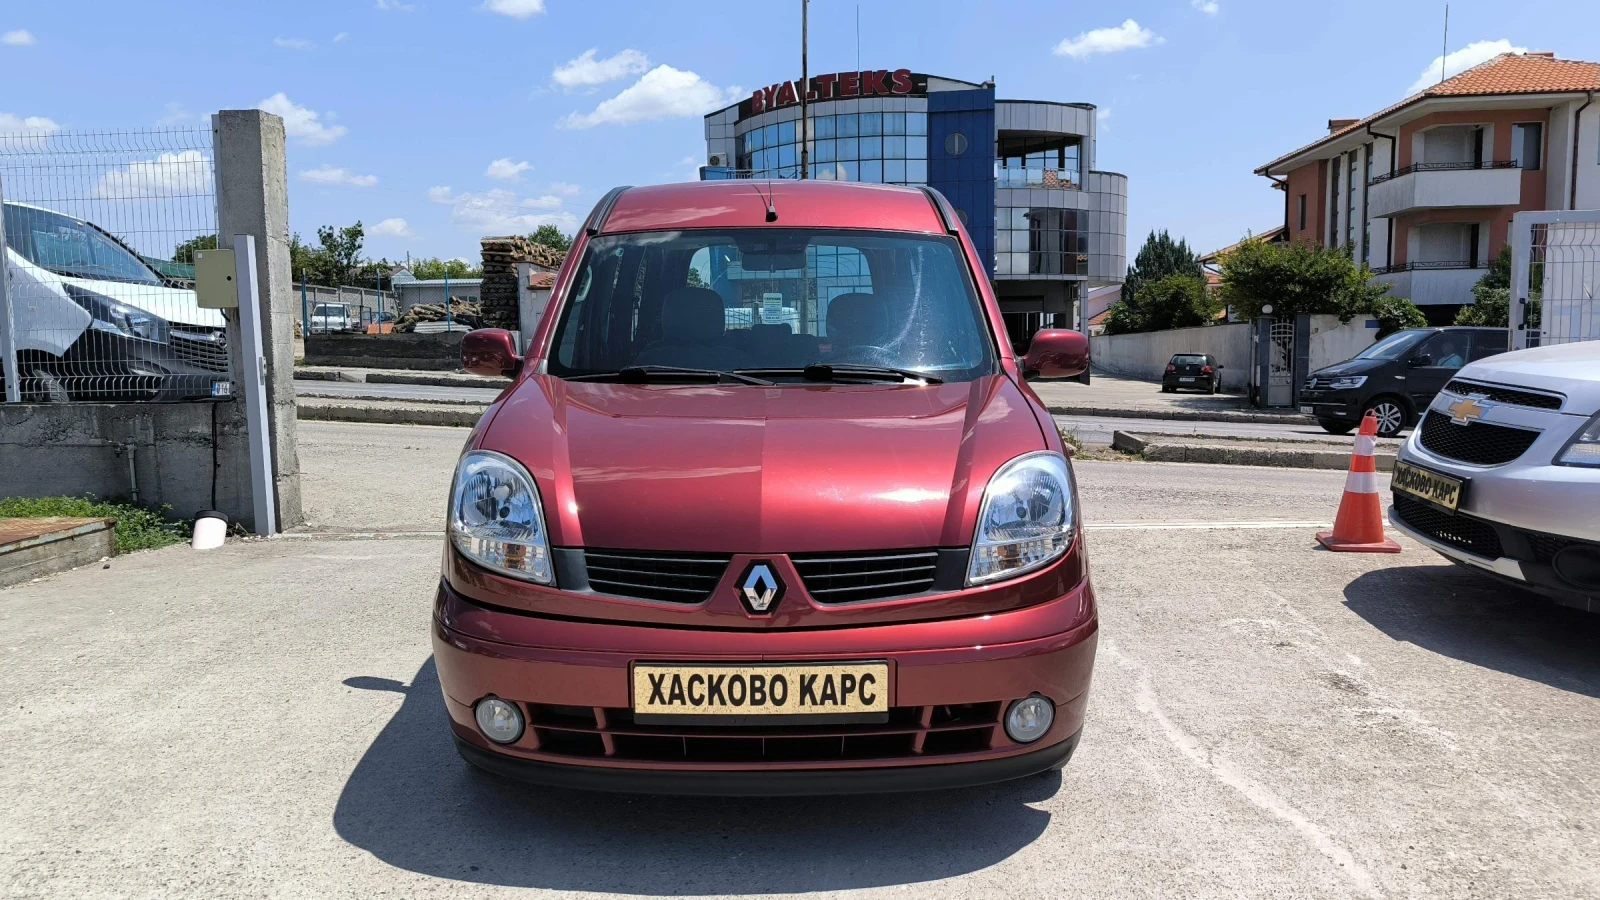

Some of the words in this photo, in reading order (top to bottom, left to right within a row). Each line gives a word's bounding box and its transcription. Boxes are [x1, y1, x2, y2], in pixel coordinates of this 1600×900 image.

[752, 69, 912, 115] BYALTEKS
[1433, 480, 1456, 504] КАРС
[648, 673, 788, 706] ХАСКОВО
[799, 673, 876, 706] КАРС
